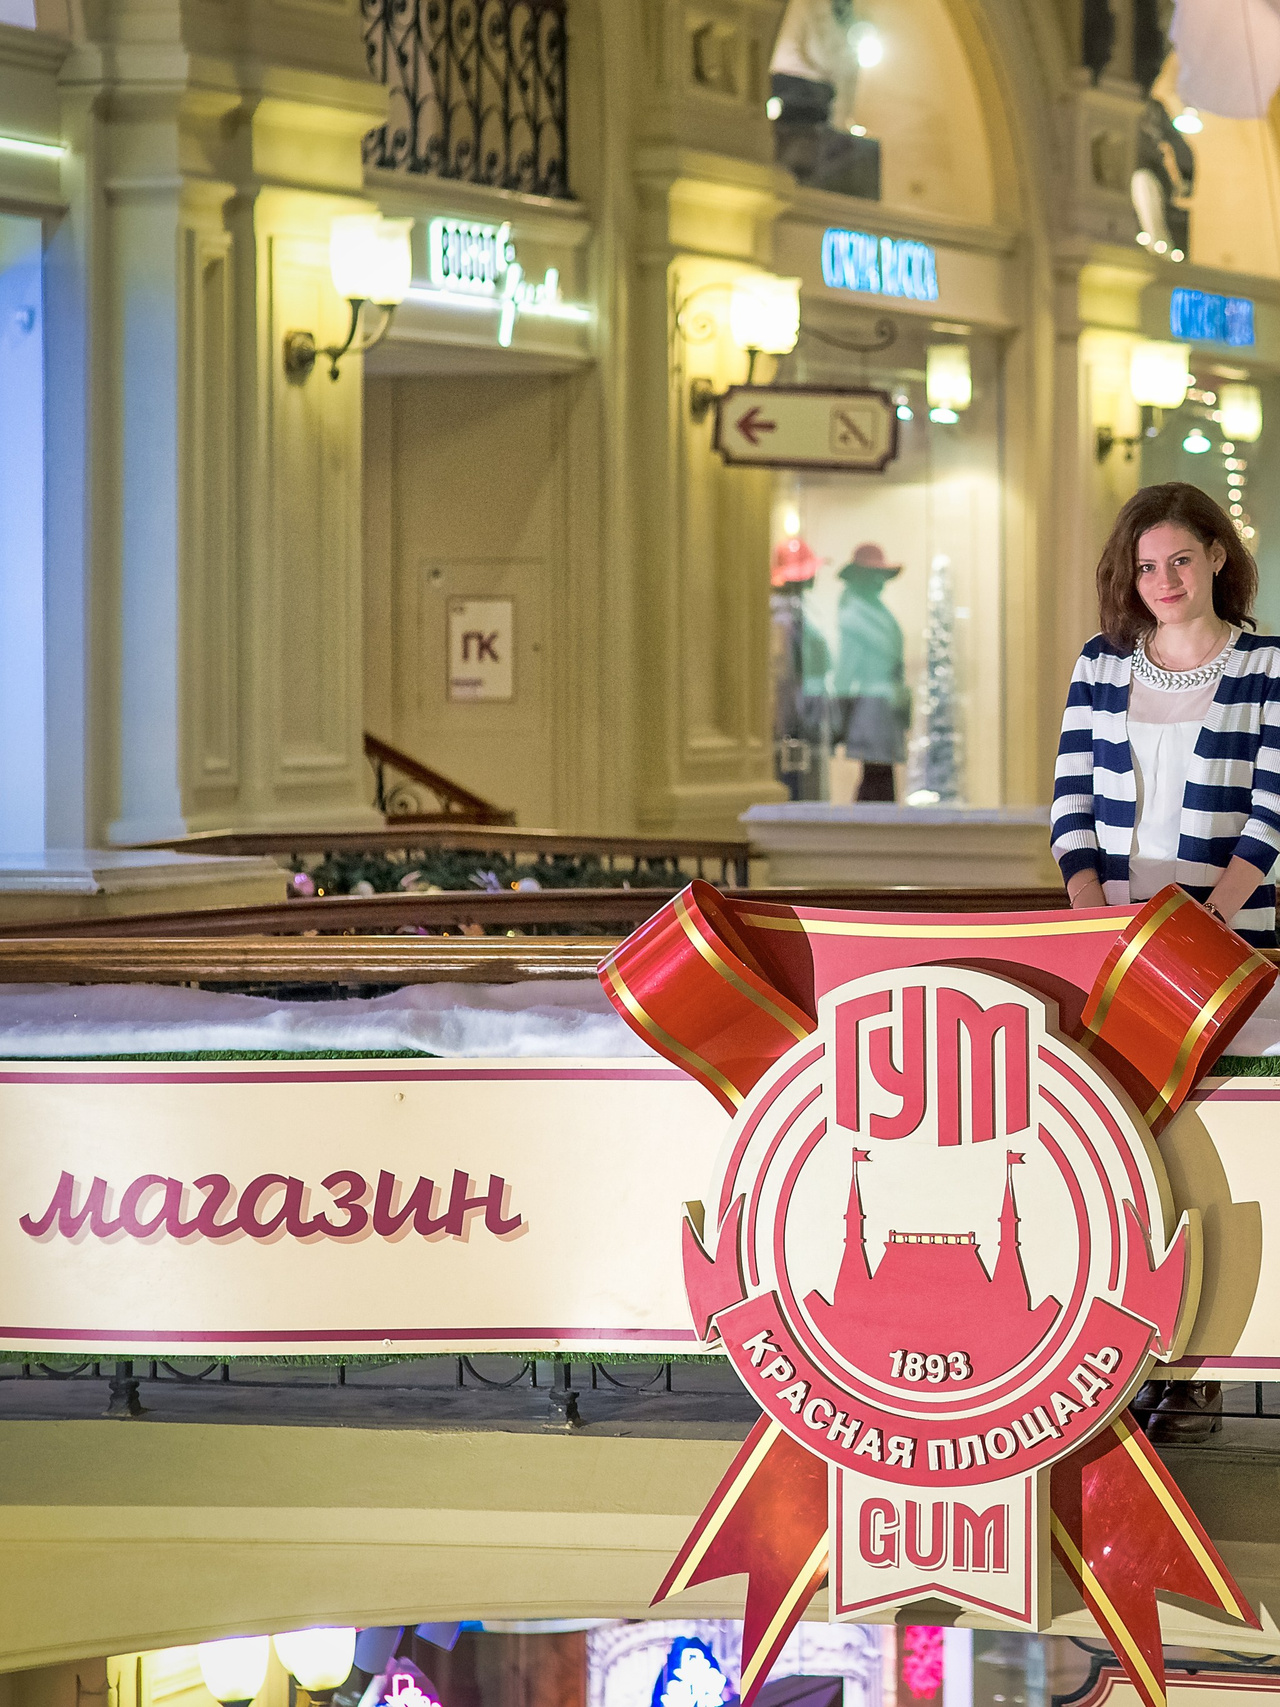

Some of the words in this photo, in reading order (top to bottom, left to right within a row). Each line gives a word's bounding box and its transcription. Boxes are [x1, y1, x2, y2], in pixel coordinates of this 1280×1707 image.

[835, 986, 1031, 1147] ГУМ
[18, 1168, 525, 1243] магазин
[742, 1329, 918, 1470] КРАСНАЯ
[927, 1344, 1122, 1471] ПЛОЩАДЬ
[889, 1349, 973, 1384] 1893
[858, 1497, 1010, 1573] GUM
